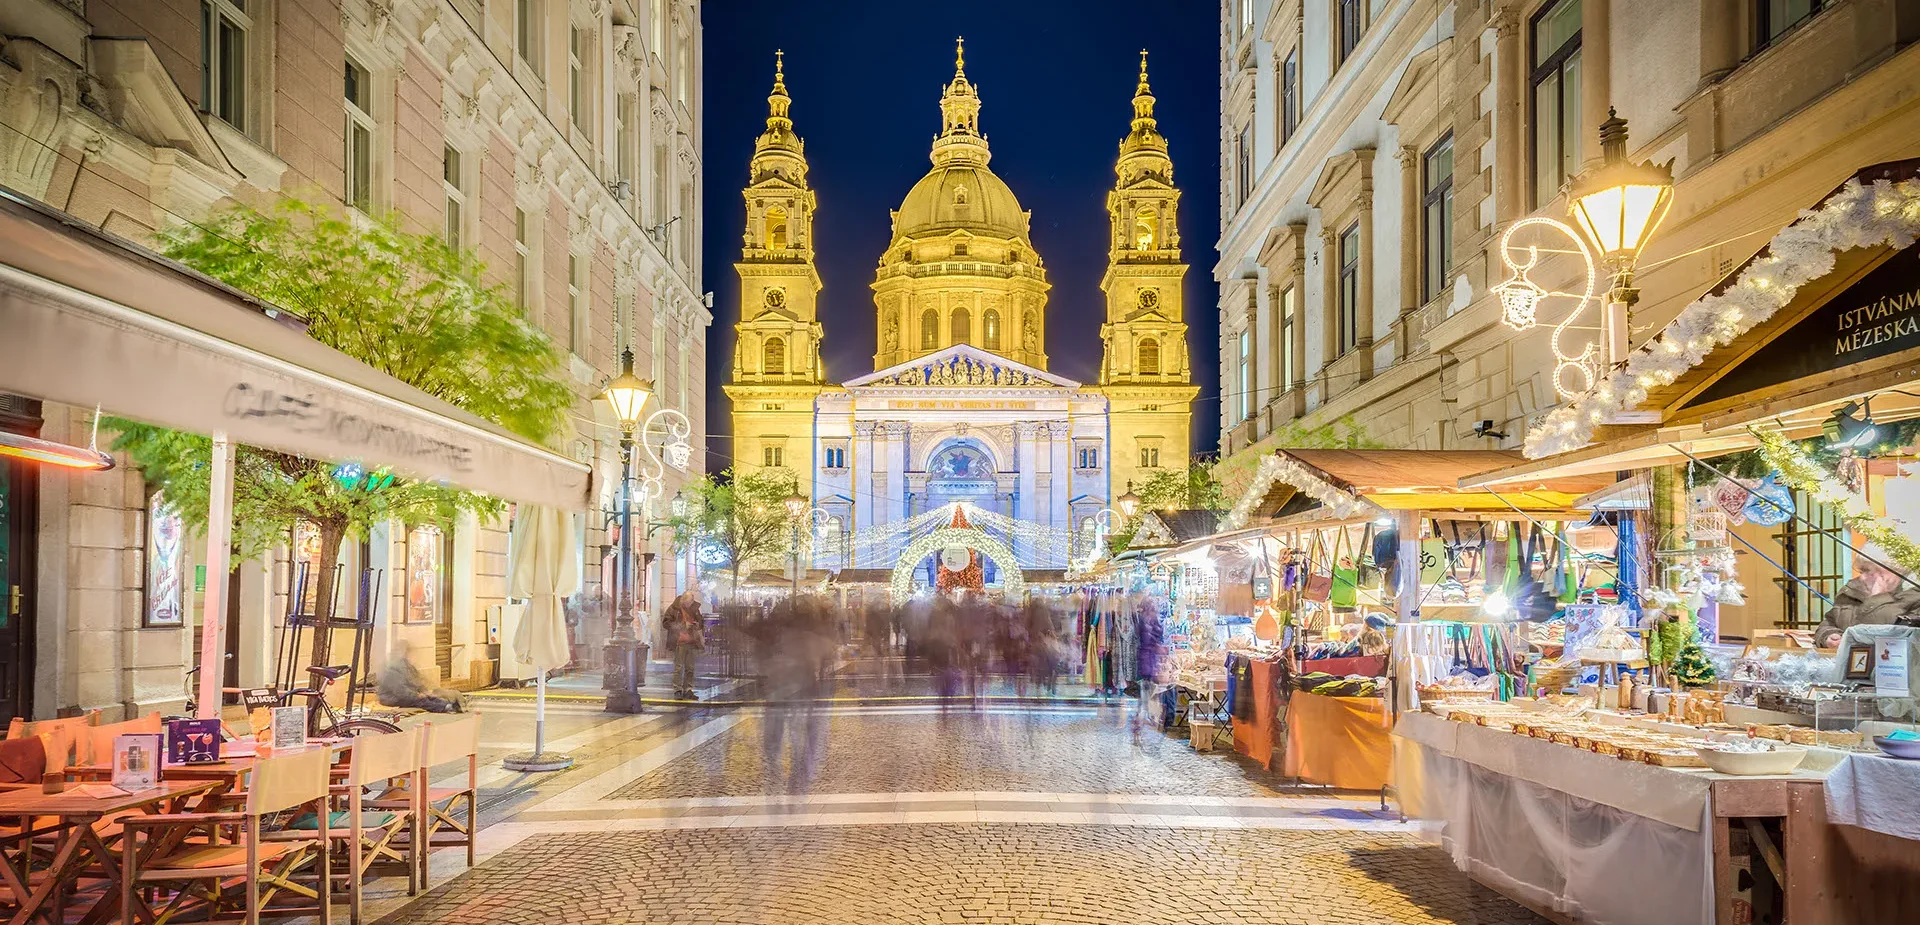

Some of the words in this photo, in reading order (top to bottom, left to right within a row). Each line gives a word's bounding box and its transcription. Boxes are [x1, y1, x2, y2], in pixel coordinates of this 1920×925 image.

[896, 400, 914, 409] EGO
[941, 400, 955, 409] VIA
[959, 400, 992, 409] VERITAS
[995, 400, 1004, 409] ET
[156, 567, 172, 587] ICE
[151, 578, 178, 611] CREAM
